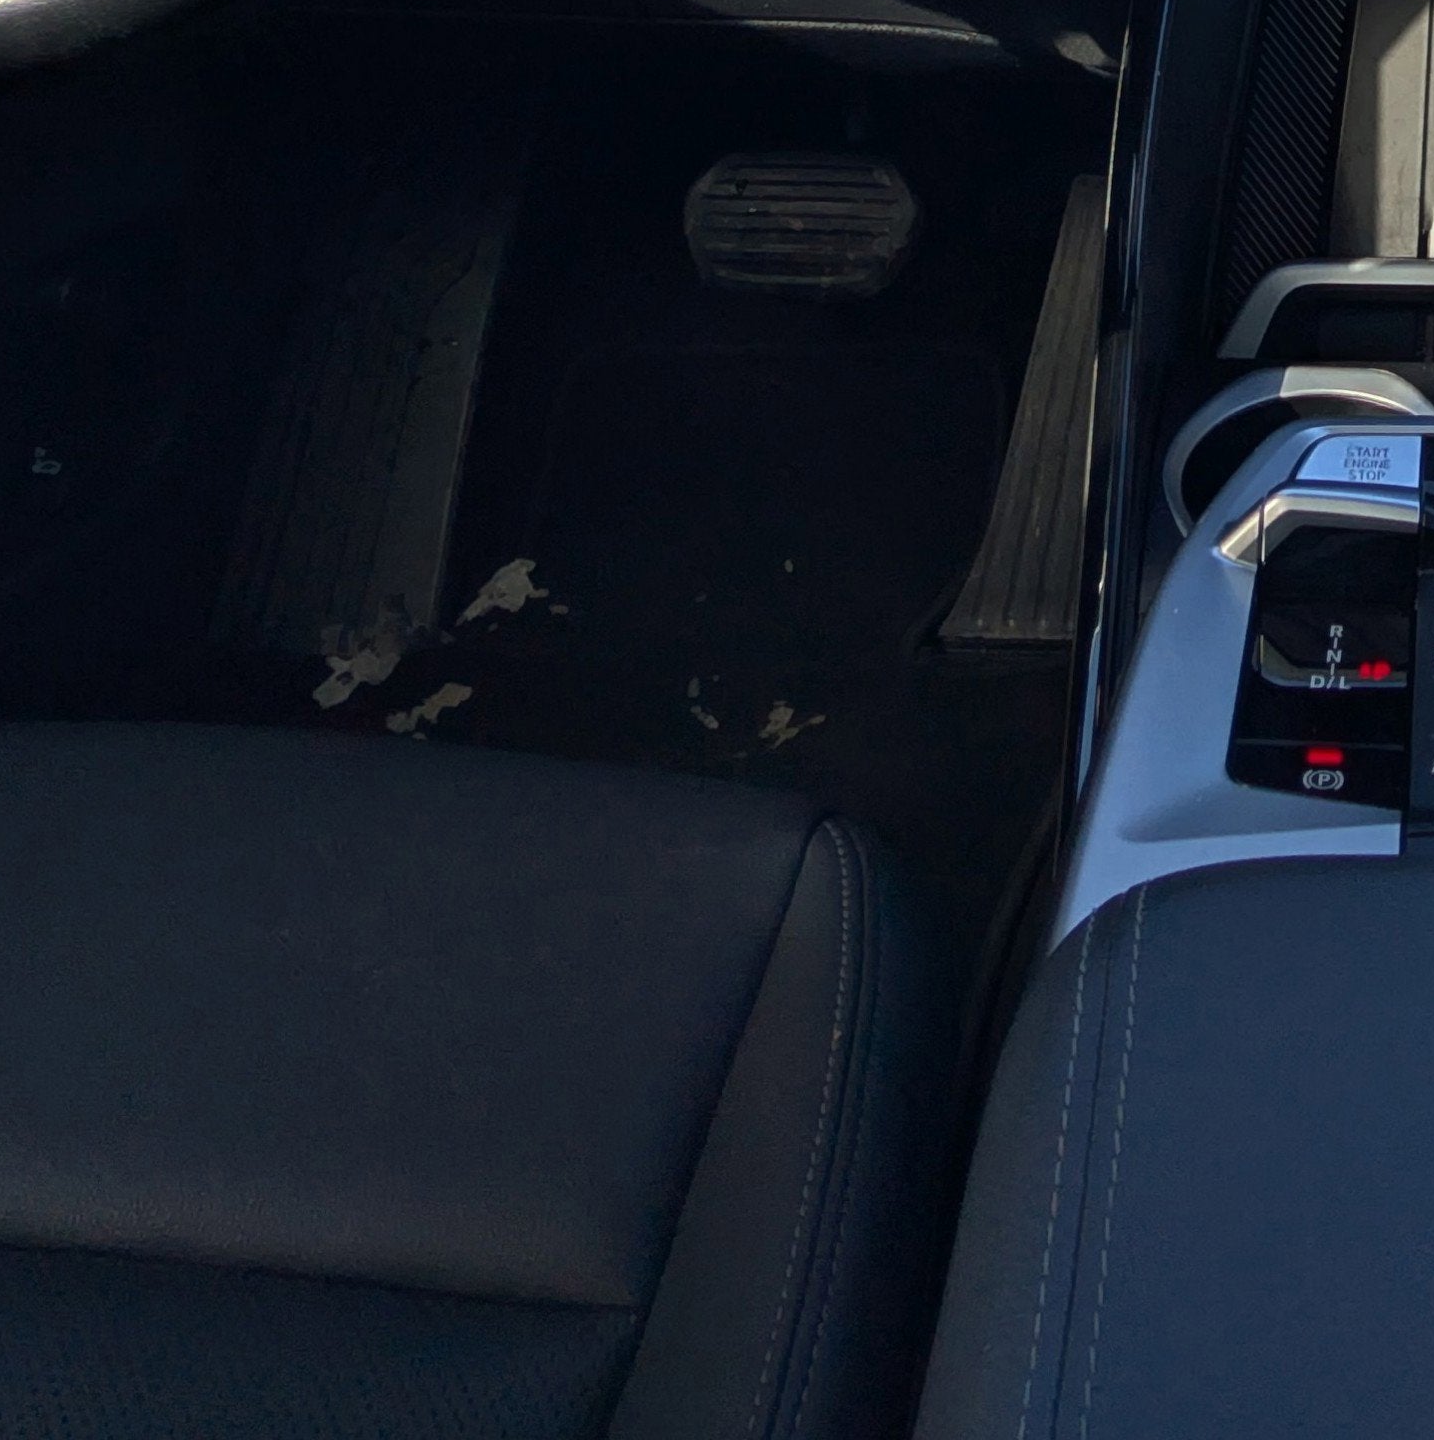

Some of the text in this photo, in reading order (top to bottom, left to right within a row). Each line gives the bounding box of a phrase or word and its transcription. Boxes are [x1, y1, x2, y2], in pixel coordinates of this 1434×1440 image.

[1346, 445, 1391, 458] START
[1343, 458, 1391, 470] ENGINE
[1348, 470, 1387, 482] STOP
[1329, 624, 1344, 638] R
[1326, 649, 1343, 663] N
